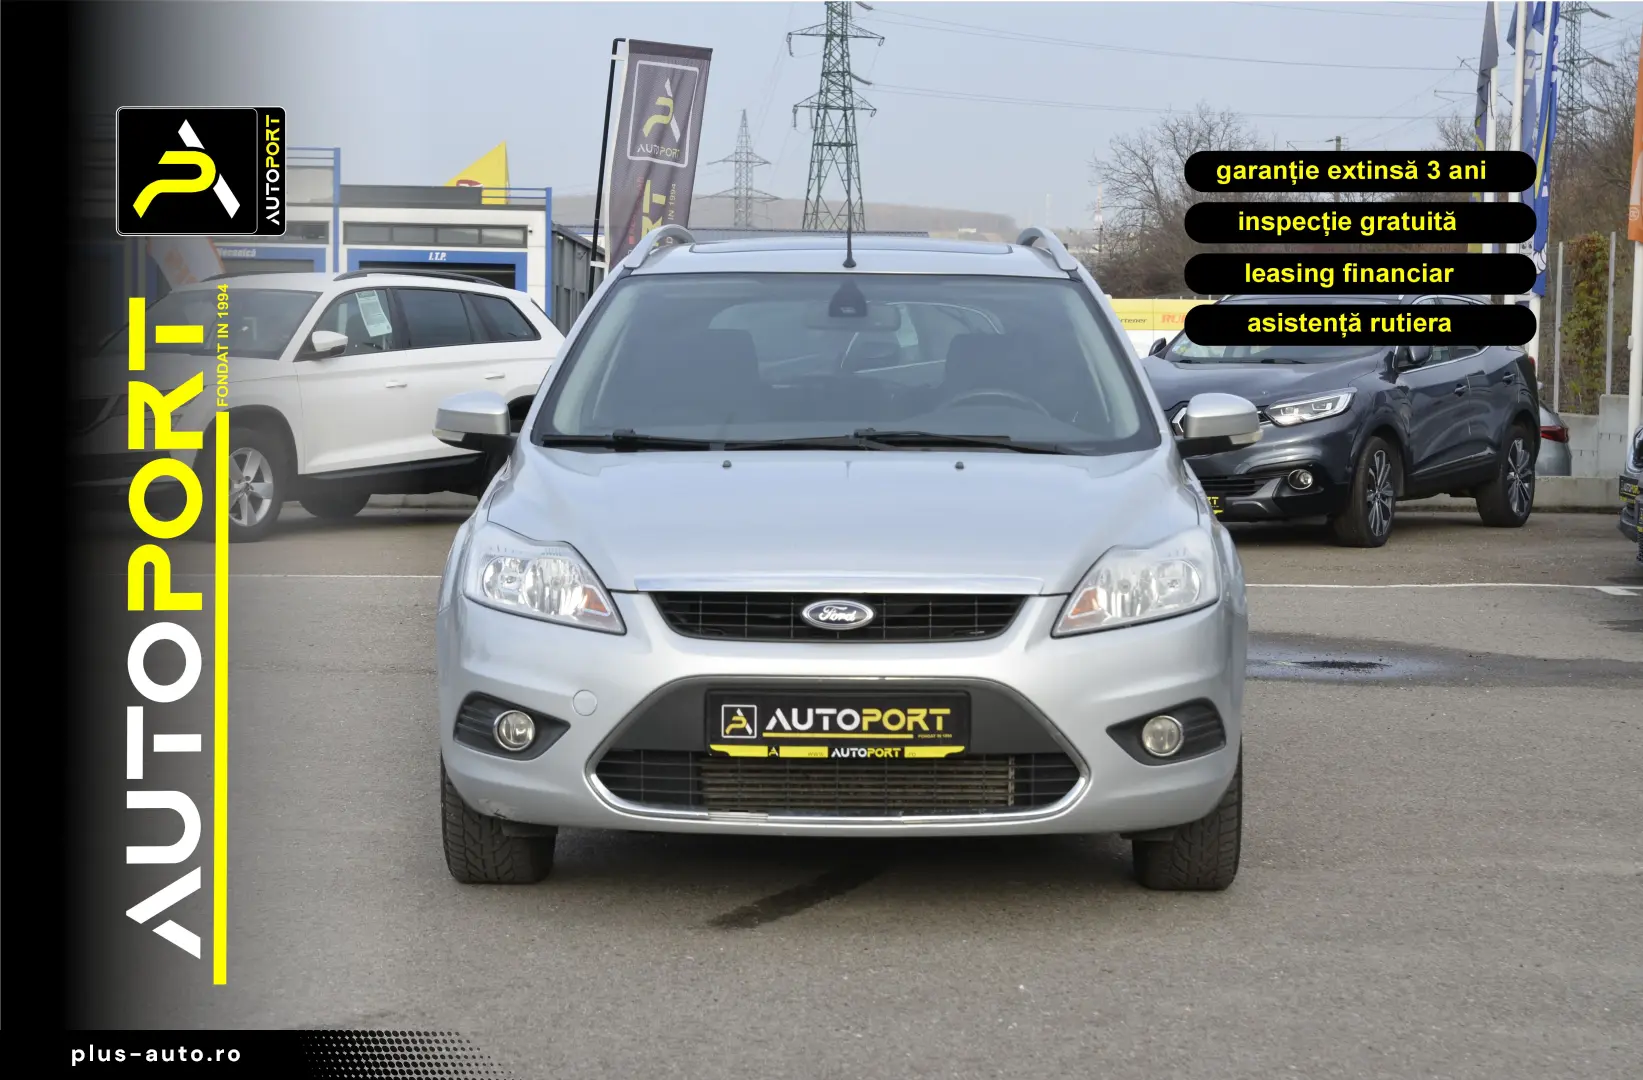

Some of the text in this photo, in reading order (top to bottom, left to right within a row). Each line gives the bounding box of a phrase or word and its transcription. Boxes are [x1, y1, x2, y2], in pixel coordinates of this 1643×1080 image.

[818, 605, 857, 621] Ford
[765, 708, 951, 731] AUTOPORT
[831, 747, 902, 758] AUTOPORT
